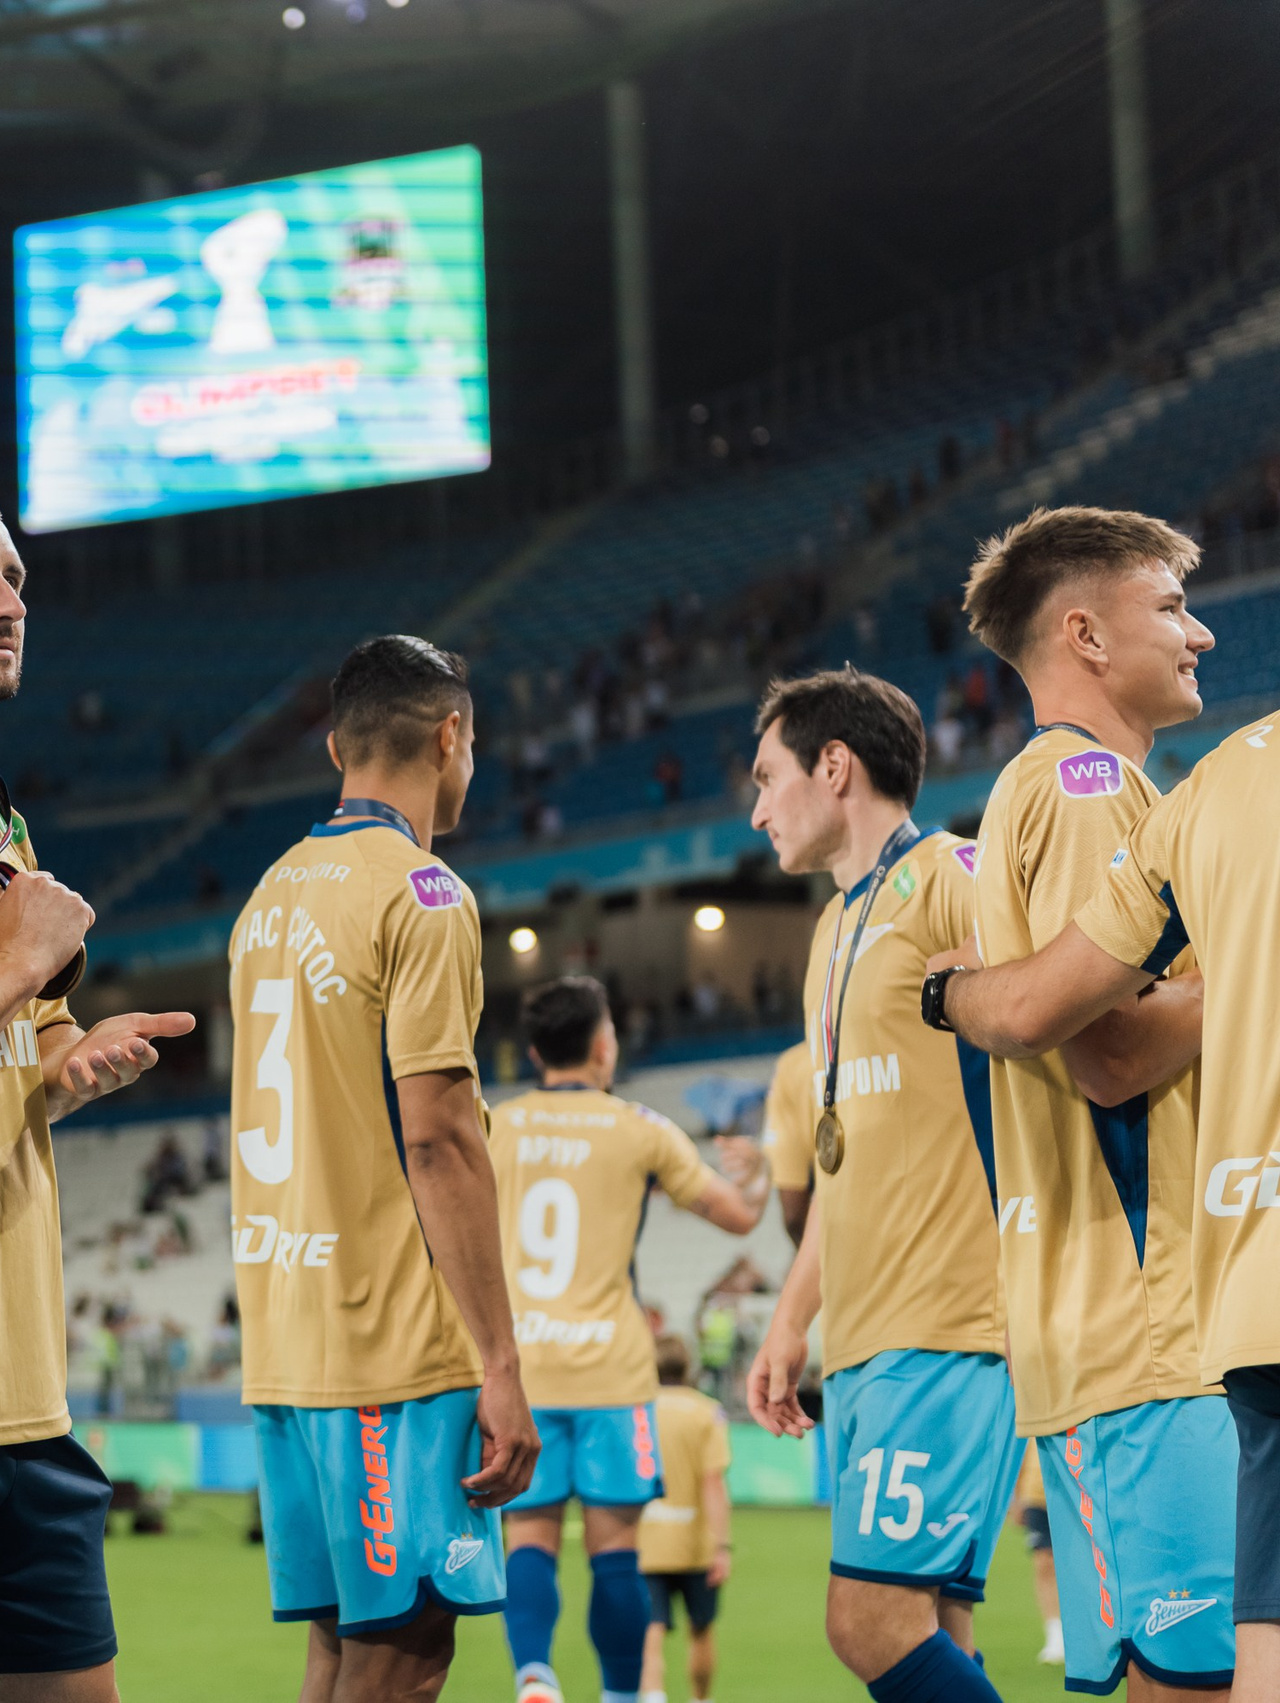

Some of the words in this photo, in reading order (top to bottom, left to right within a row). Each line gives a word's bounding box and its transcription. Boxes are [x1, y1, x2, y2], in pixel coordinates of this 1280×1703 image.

[1068, 760, 1112, 780] WB
[275, 862, 352, 883] РОСИЯ
[417, 876, 454, 894] WB
[237, 978, 294, 1184] 3
[517, 1178, 580, 1299] 9
[359, 1404, 398, 1577] G-ENERG
[858, 1447, 931, 1541] 15
